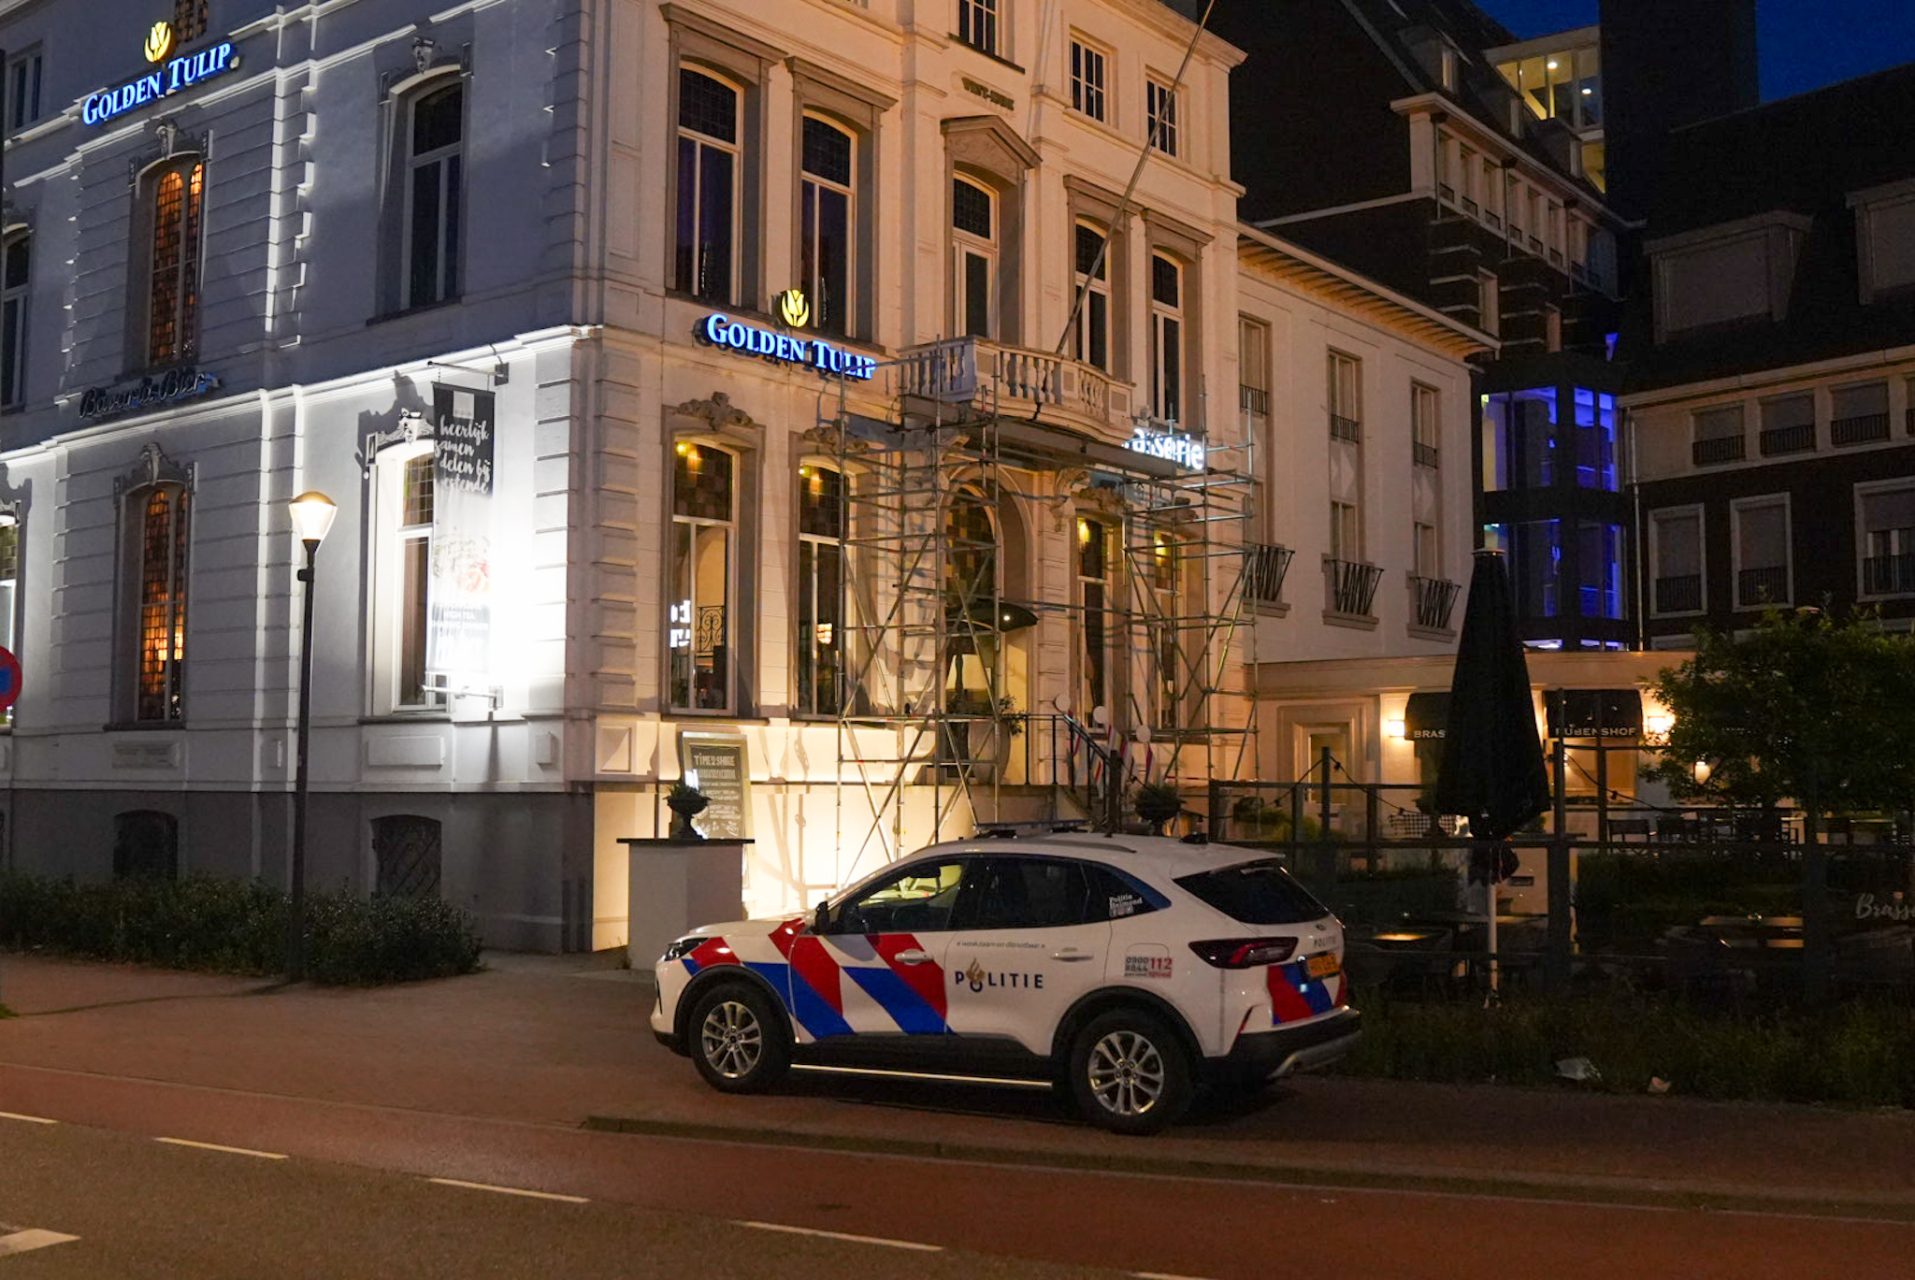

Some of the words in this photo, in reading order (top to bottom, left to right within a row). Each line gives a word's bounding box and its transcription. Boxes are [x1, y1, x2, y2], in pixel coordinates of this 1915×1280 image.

[83, 71, 161, 125] GOLDEN
[168, 42, 231, 89] TULIP
[707, 313, 806, 362] GOLDEN
[812, 339, 877, 379] TULIP
[440, 414, 490, 446] heerlijk
[434, 440, 475, 458] samen
[440, 453, 475, 475] delen
[476, 459, 491, 483] bij
[1555, 727, 1637, 737] UBENSHOF
[1151, 957, 1172, 970] 112
[955, 971, 1044, 993] POLITIE
